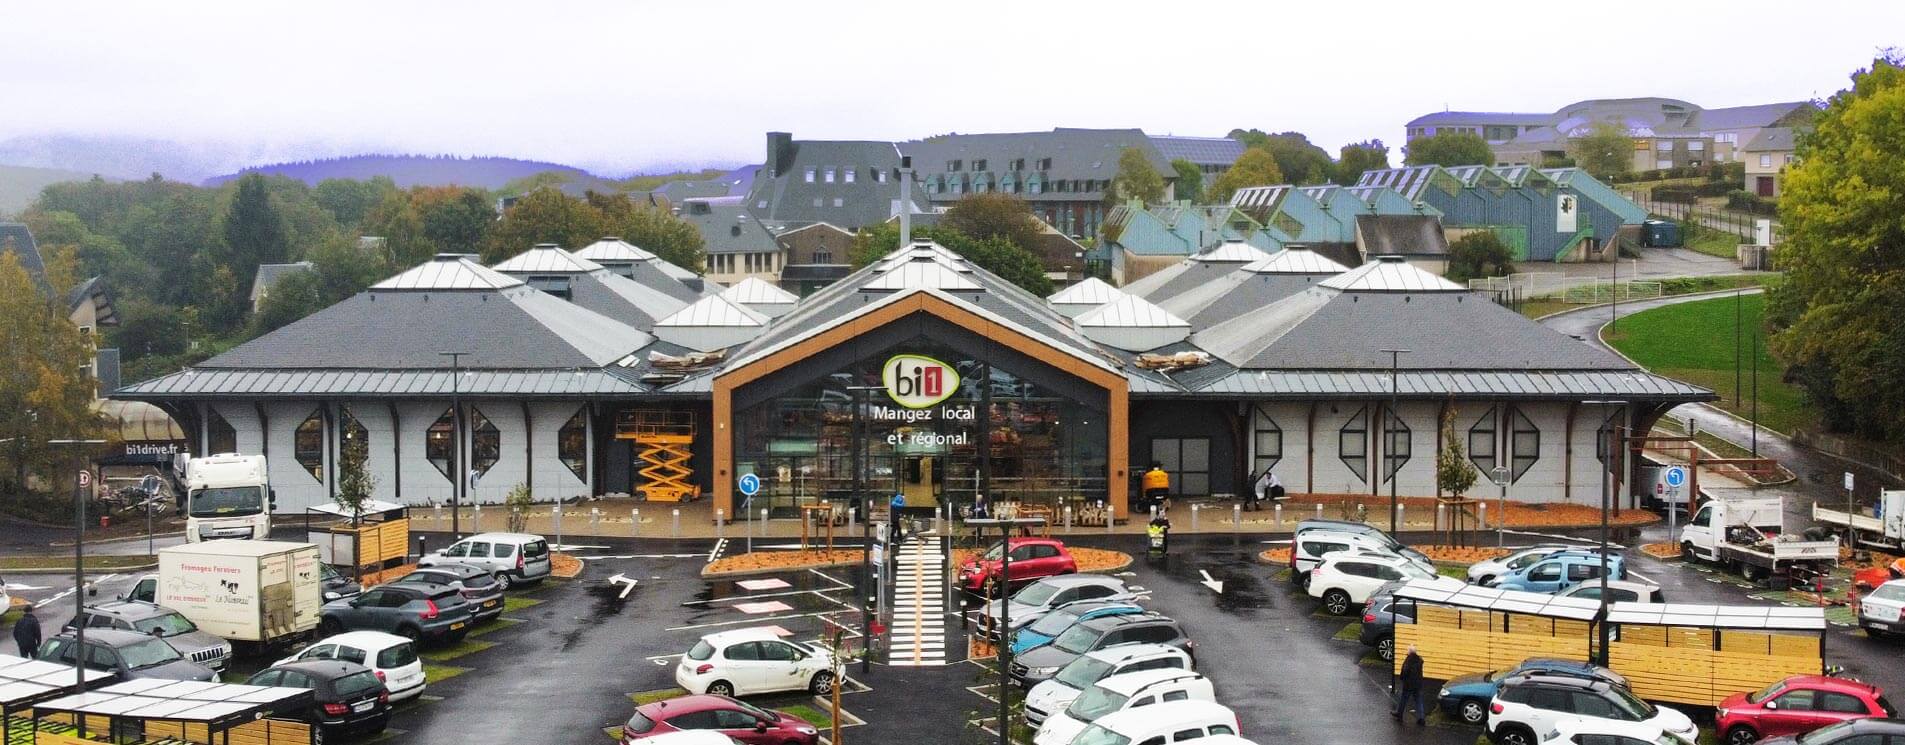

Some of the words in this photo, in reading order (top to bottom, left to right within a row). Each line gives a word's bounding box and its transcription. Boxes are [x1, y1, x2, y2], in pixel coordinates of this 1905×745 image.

[896, 360, 942, 396] bi1
[874, 406, 932, 423] Mangez
[942, 406, 975, 420] local
[887, 432, 904, 445] et
[911, 431, 967, 447] régional
[126, 443, 178, 455] bi1drive.fr
